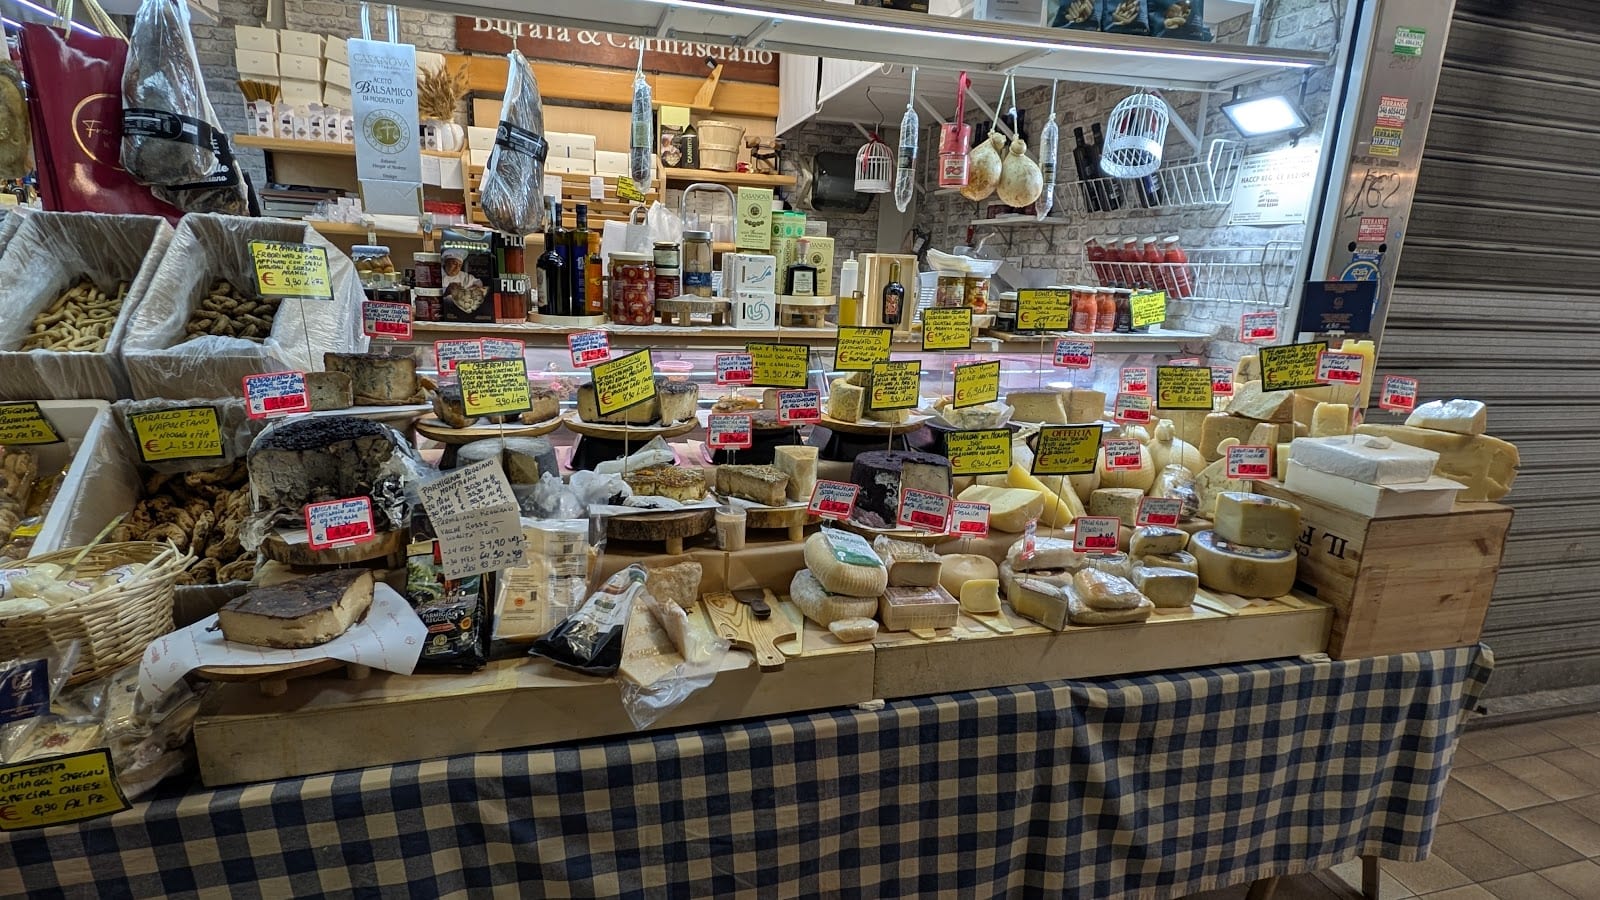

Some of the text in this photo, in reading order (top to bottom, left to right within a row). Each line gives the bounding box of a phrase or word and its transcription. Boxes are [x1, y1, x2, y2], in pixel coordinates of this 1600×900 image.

[577, 30, 601, 45] &
[353, 53, 410, 68] CASANOVA
[370, 95, 394, 104] MODENA
[1381, 99, 1407, 107] SERRANDE
[444, 241, 489, 250] CANNITO
[261, 272, 277, 286] €
[1020, 311, 1029, 322] €
[839, 351, 849, 362] €
[1267, 371, 1277, 382] €
[467, 392, 480, 406] €
[600, 391, 613, 405] €
[874, 388, 883, 401] €
[1161, 390, 1171, 401] €
[136, 412, 181, 423] TARALLO
[148, 419, 209, 432] NAPOLETANO
[144, 439, 161, 453] €
[951, 455, 961, 467] €
[1038, 454, 1048, 466] €
[422, 473, 462, 496] PARMIGIANO
[0, 763, 66, 784] OFFERTA
[60, 765, 104, 782] SPECIALI
[0, 789, 54, 805] SPECIAL
[0, 805, 22, 820] €
[32, 803, 58, 816] 8,90
[64, 799, 83, 810] AL
